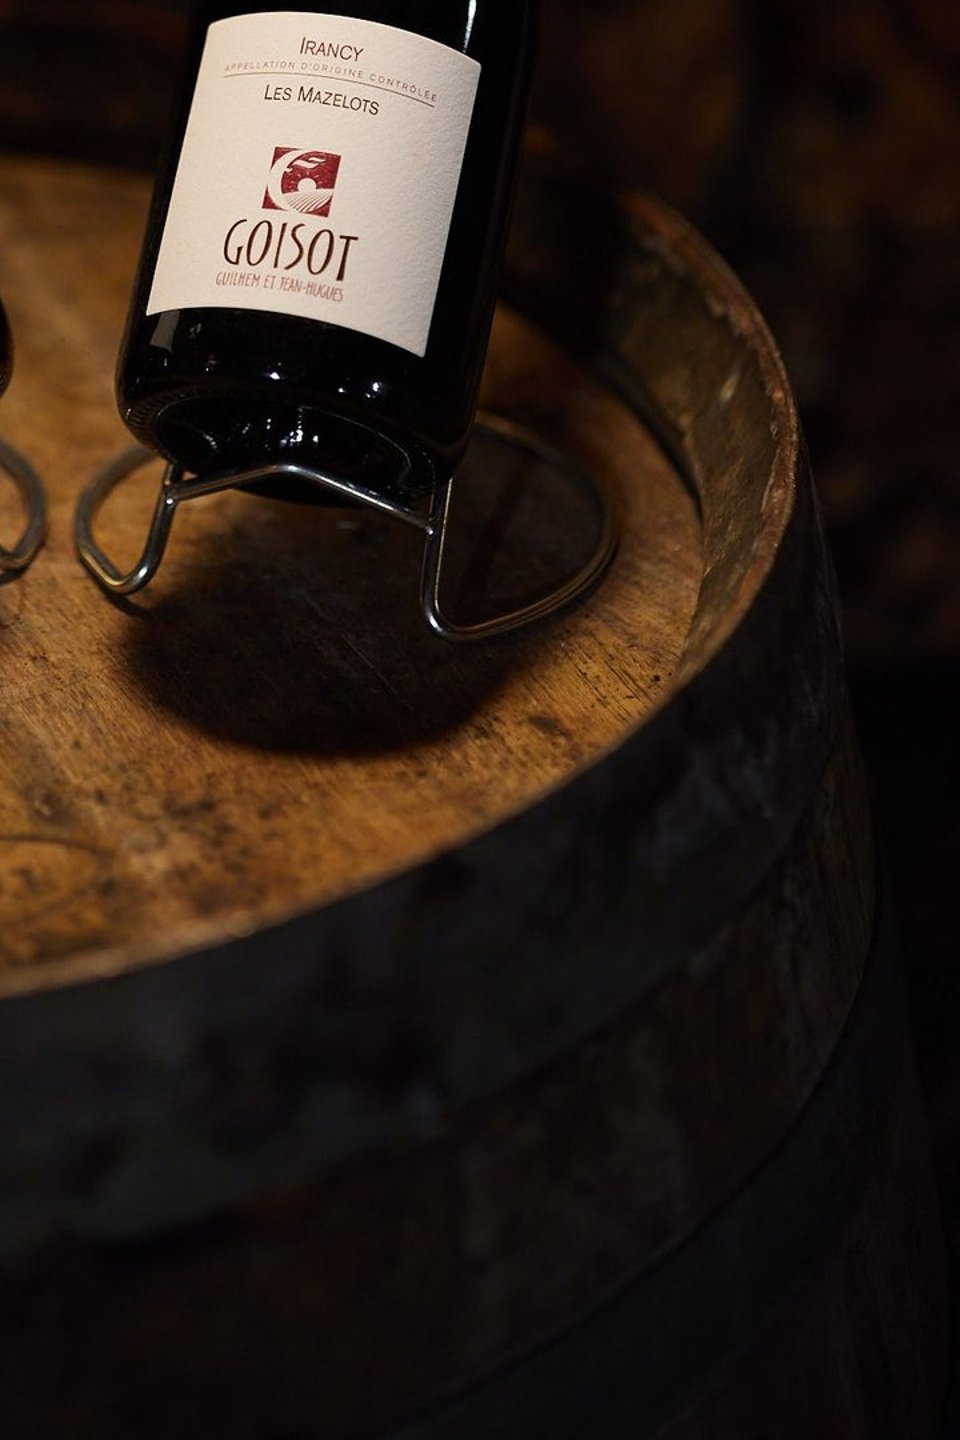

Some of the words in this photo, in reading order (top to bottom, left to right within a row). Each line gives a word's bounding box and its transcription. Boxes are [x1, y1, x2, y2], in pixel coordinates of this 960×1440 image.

[299, 37, 364, 61] IRANCY
[225, 60, 295, 71] APPELLATION
[263, 84, 292, 101] LES
[297, 85, 380, 116] MAZELOTS
[223, 218, 360, 282] GOISOT
[215, 271, 262, 287] GUILHEM
[263, 274, 279, 289] ET
[280, 276, 344, 303] JEAN-HUGUES
